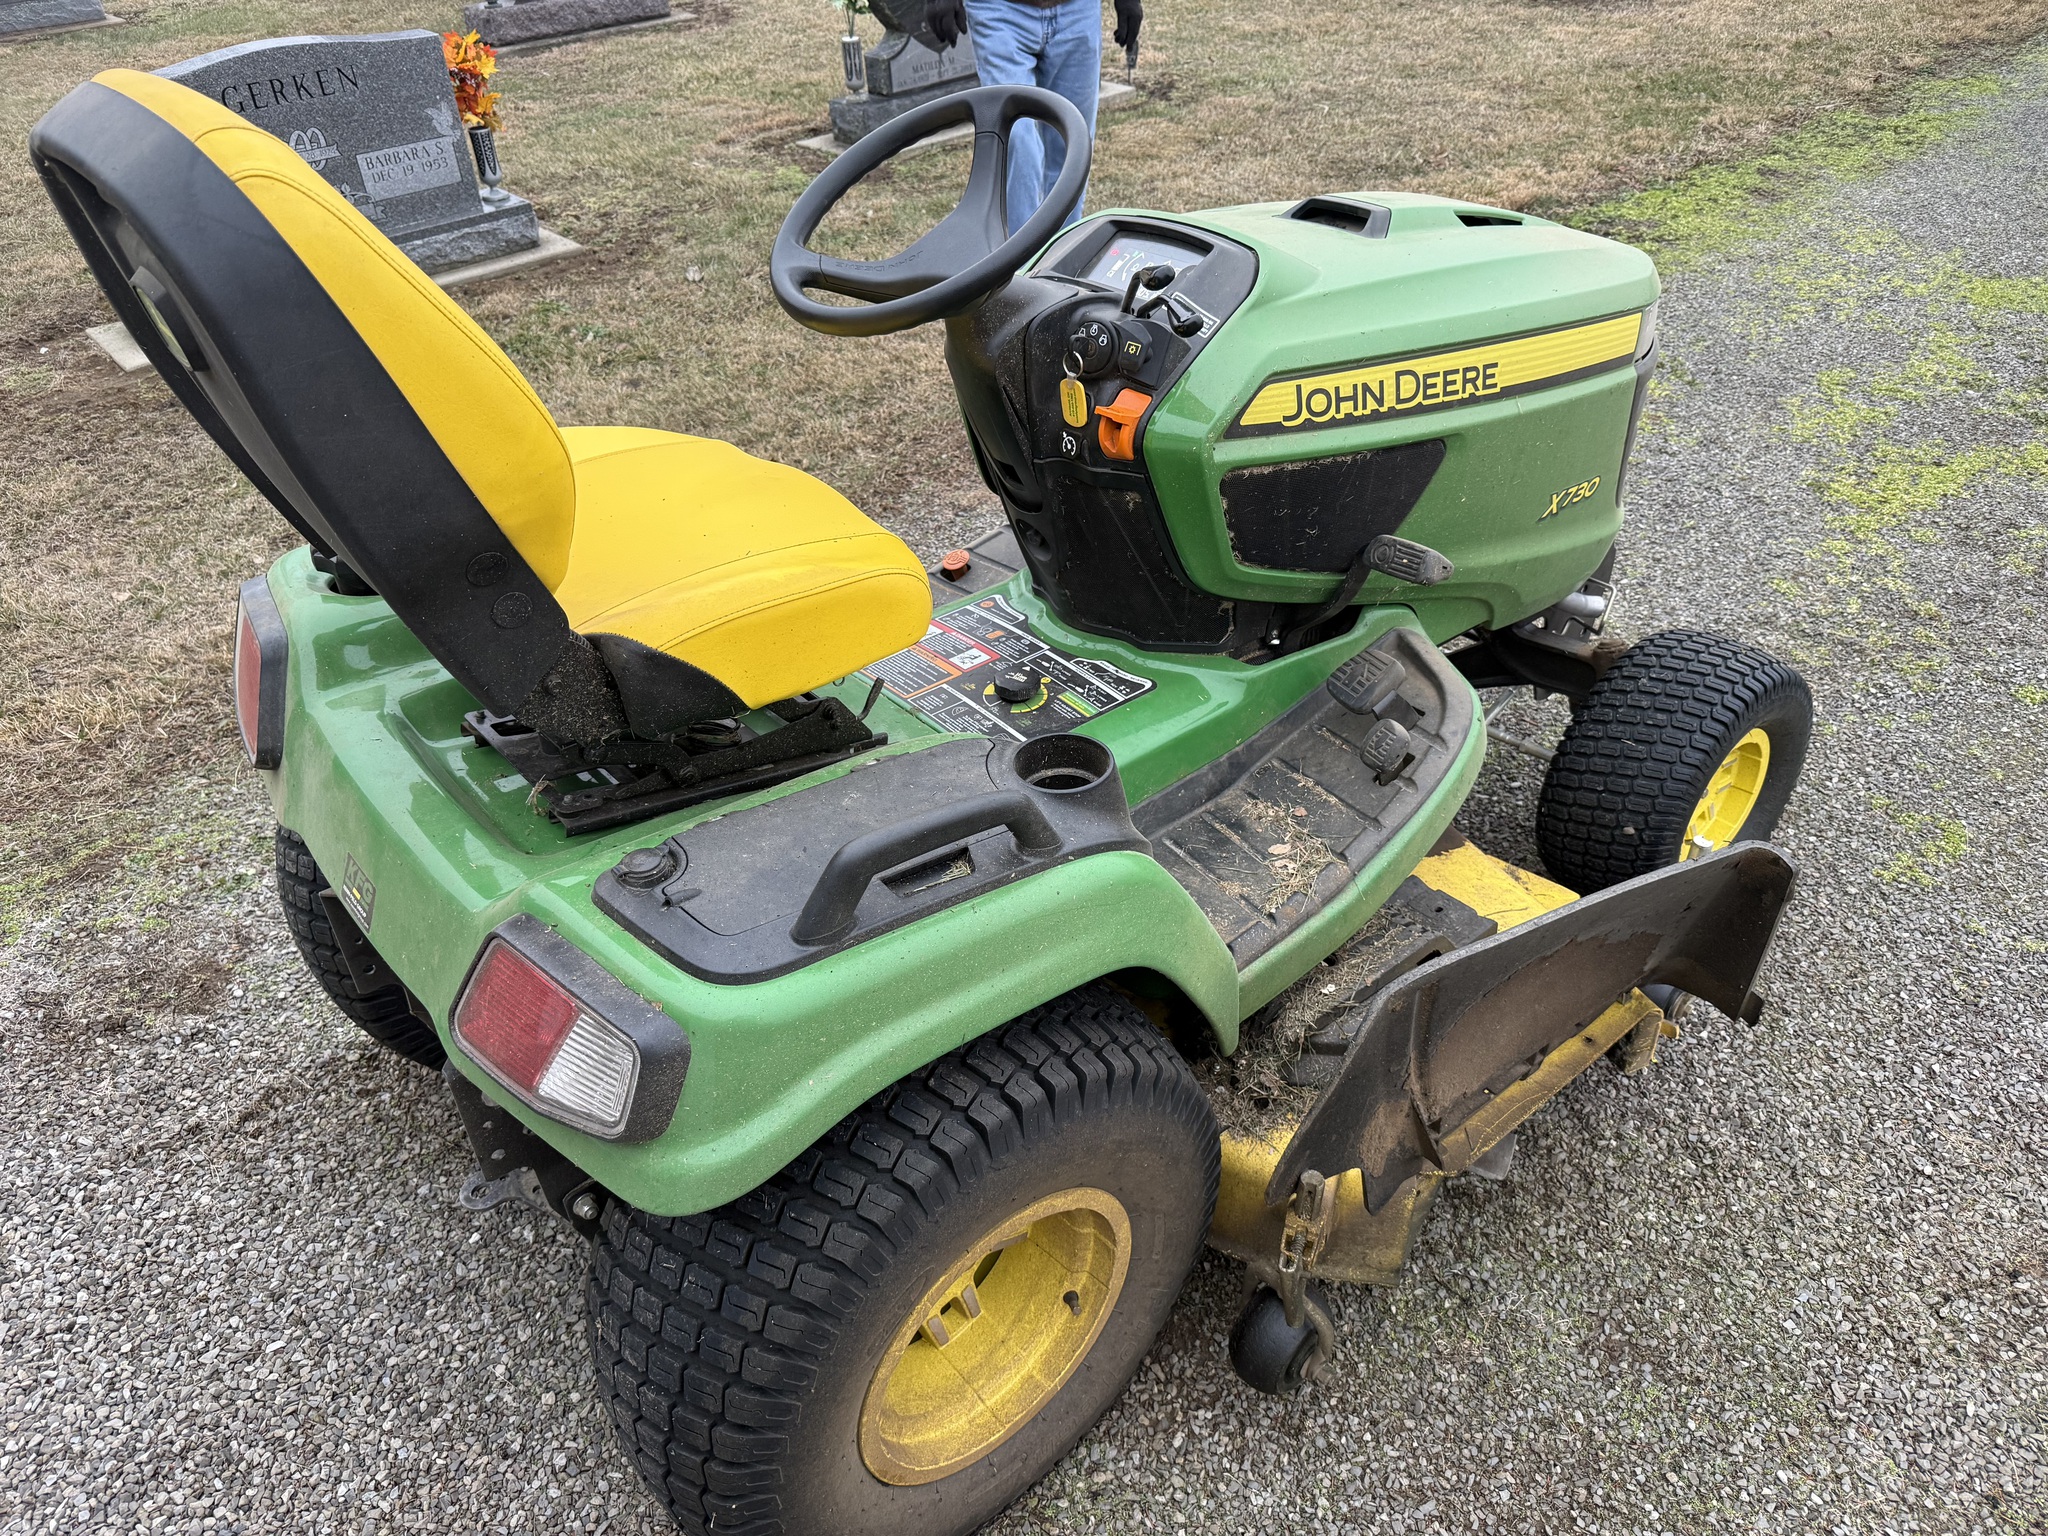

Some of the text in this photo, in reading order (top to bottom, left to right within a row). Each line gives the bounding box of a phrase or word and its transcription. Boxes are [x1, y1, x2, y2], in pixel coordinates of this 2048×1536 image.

[221, 64, 360, 114] GERKEN
[364, 145, 431, 171] BARBARA
[1282, 361, 1500, 424] JOHN DEERE
[1539, 475, 1601, 520] X730
